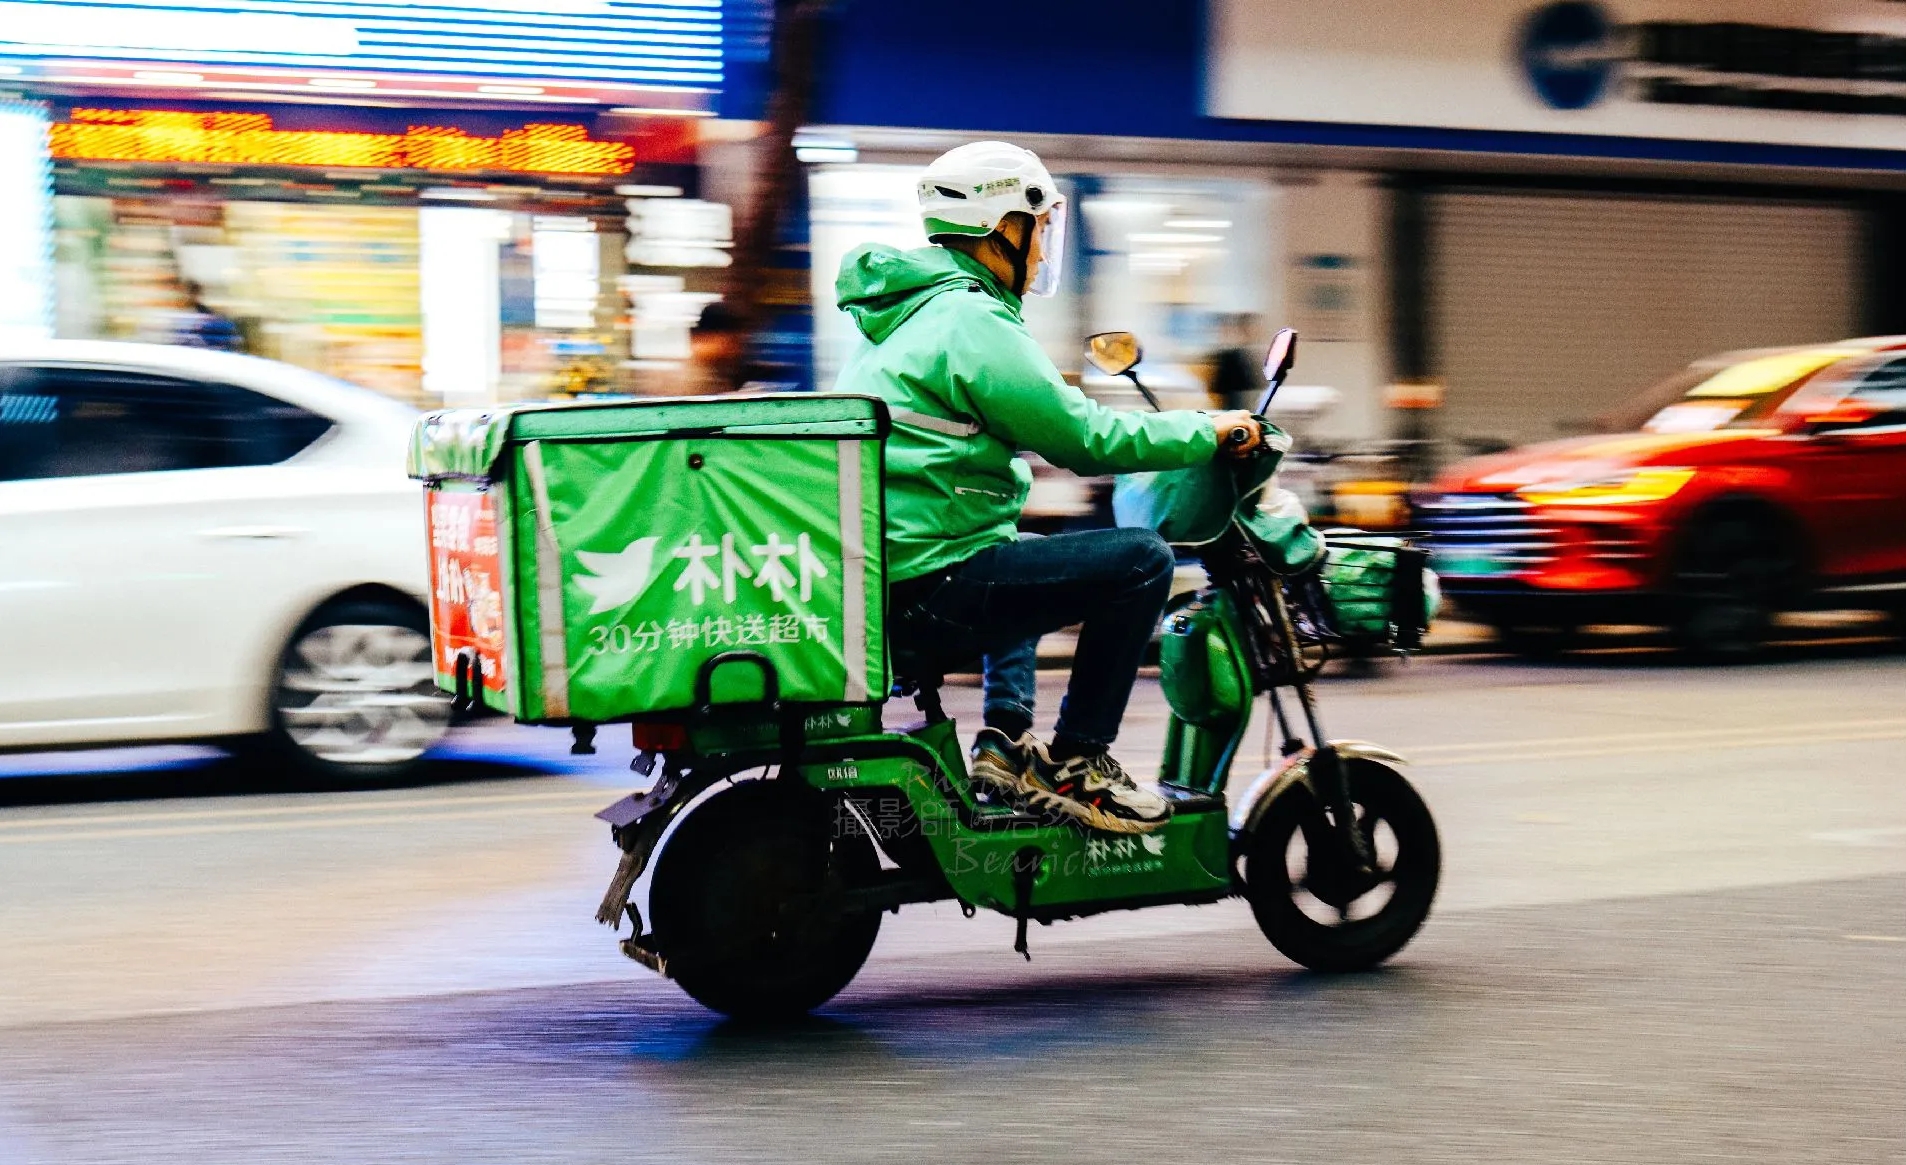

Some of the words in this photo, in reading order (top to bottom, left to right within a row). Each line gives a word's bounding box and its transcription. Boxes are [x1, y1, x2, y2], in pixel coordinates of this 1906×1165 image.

[673, 531, 829, 606] 朴朴
[587, 613, 830, 657] 30分钟快送超市
